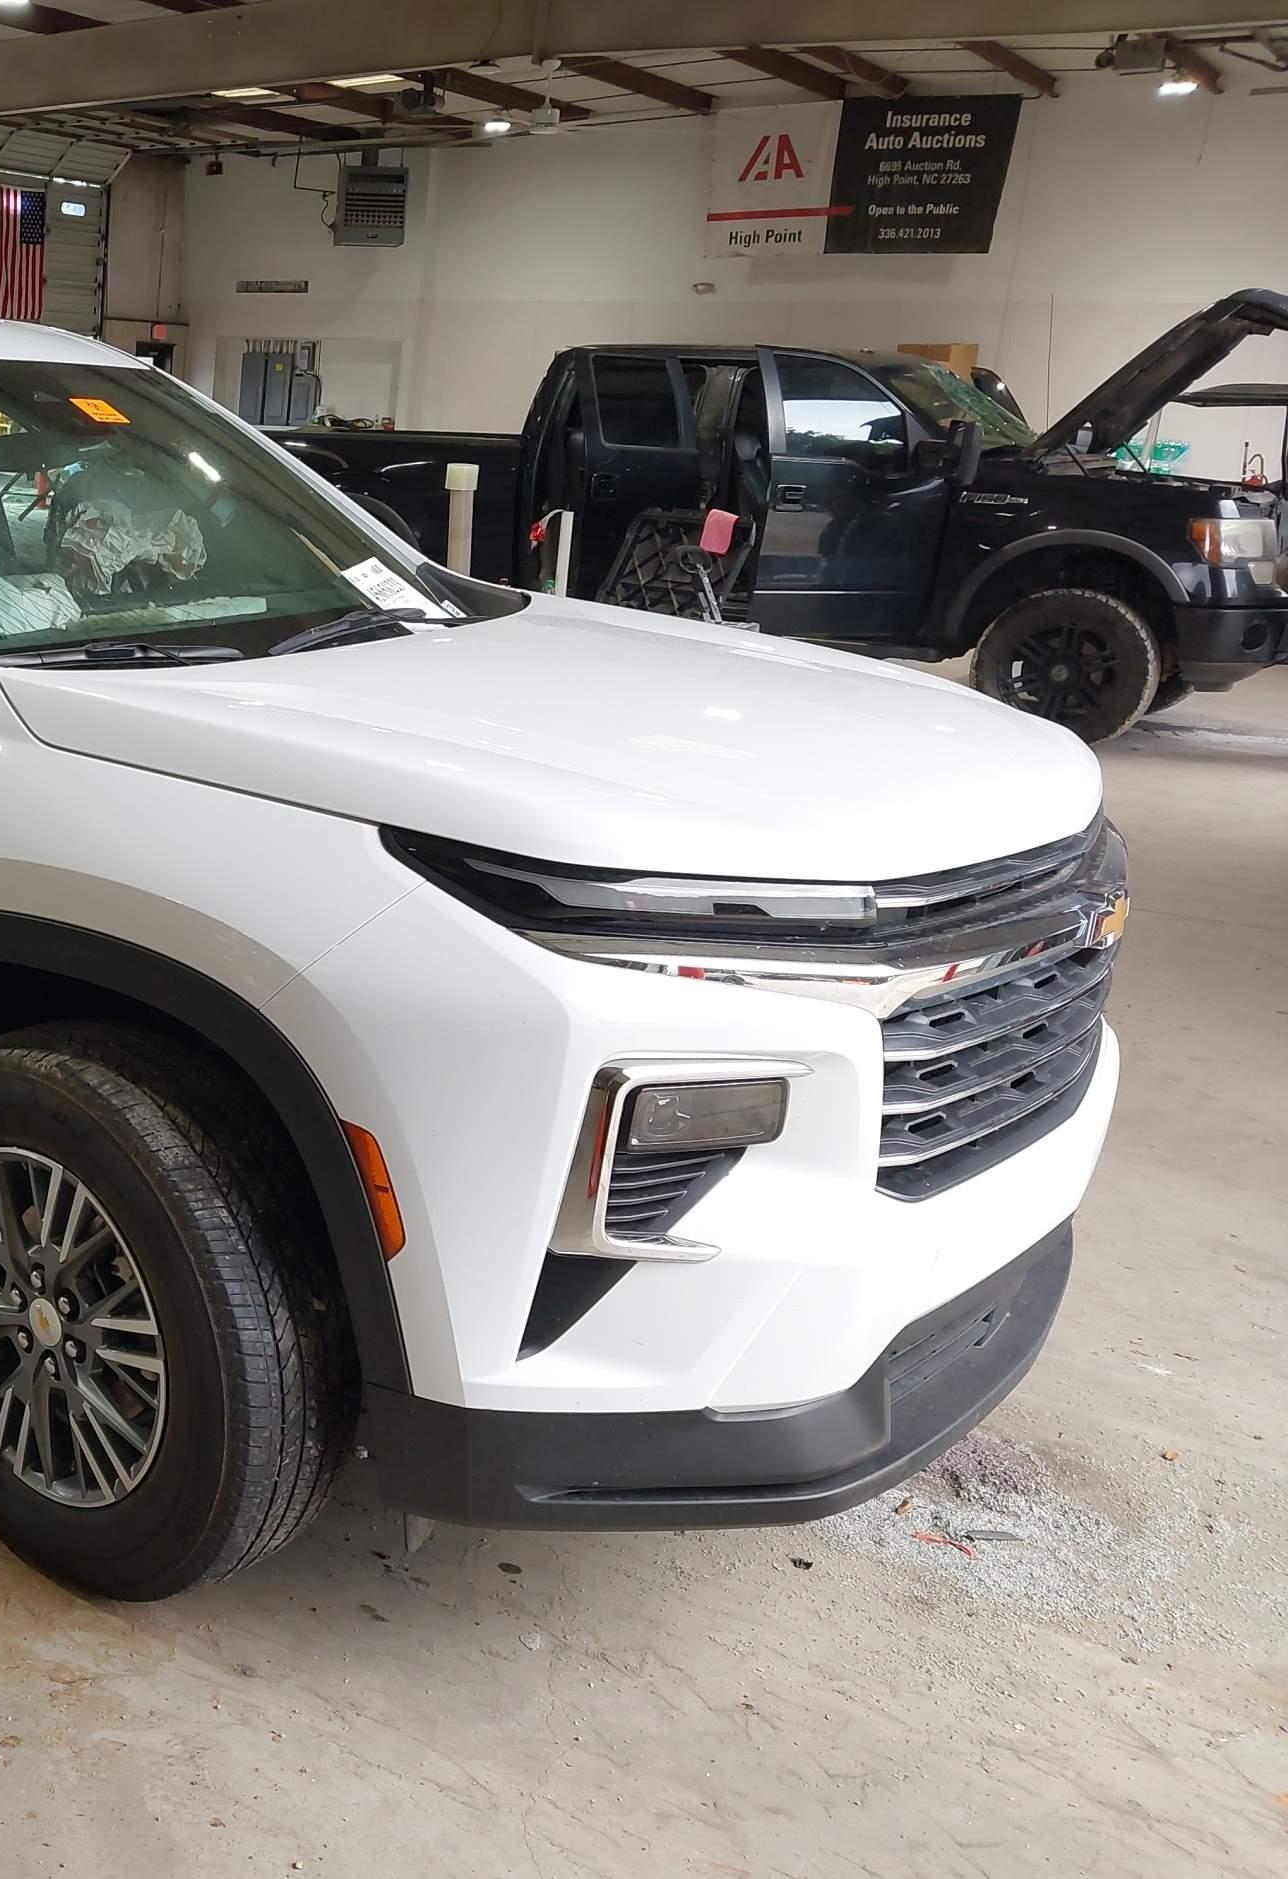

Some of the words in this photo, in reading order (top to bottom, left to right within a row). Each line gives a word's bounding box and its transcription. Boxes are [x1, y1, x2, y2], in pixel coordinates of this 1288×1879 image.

[885, 110, 972, 128] Insurance
[864, 132, 904, 150] Auto
[907, 130, 986, 148] Auctions
[904, 159, 944, 171] Auction
[945, 159, 962, 171] Rd.
[867, 175, 891, 188] High
[892, 174, 919, 185] Point,
[921, 173, 938, 185] NC
[939, 173, 971, 184] 27263
[868, 204, 894, 218] Open
[896, 206, 906, 215] to
[907, 204, 924, 215] the
[925, 203, 959, 215] Public
[729, 230, 761, 248] High
[765, 228, 803, 243] Point
[878, 227, 941, 239] 336.421.2013
